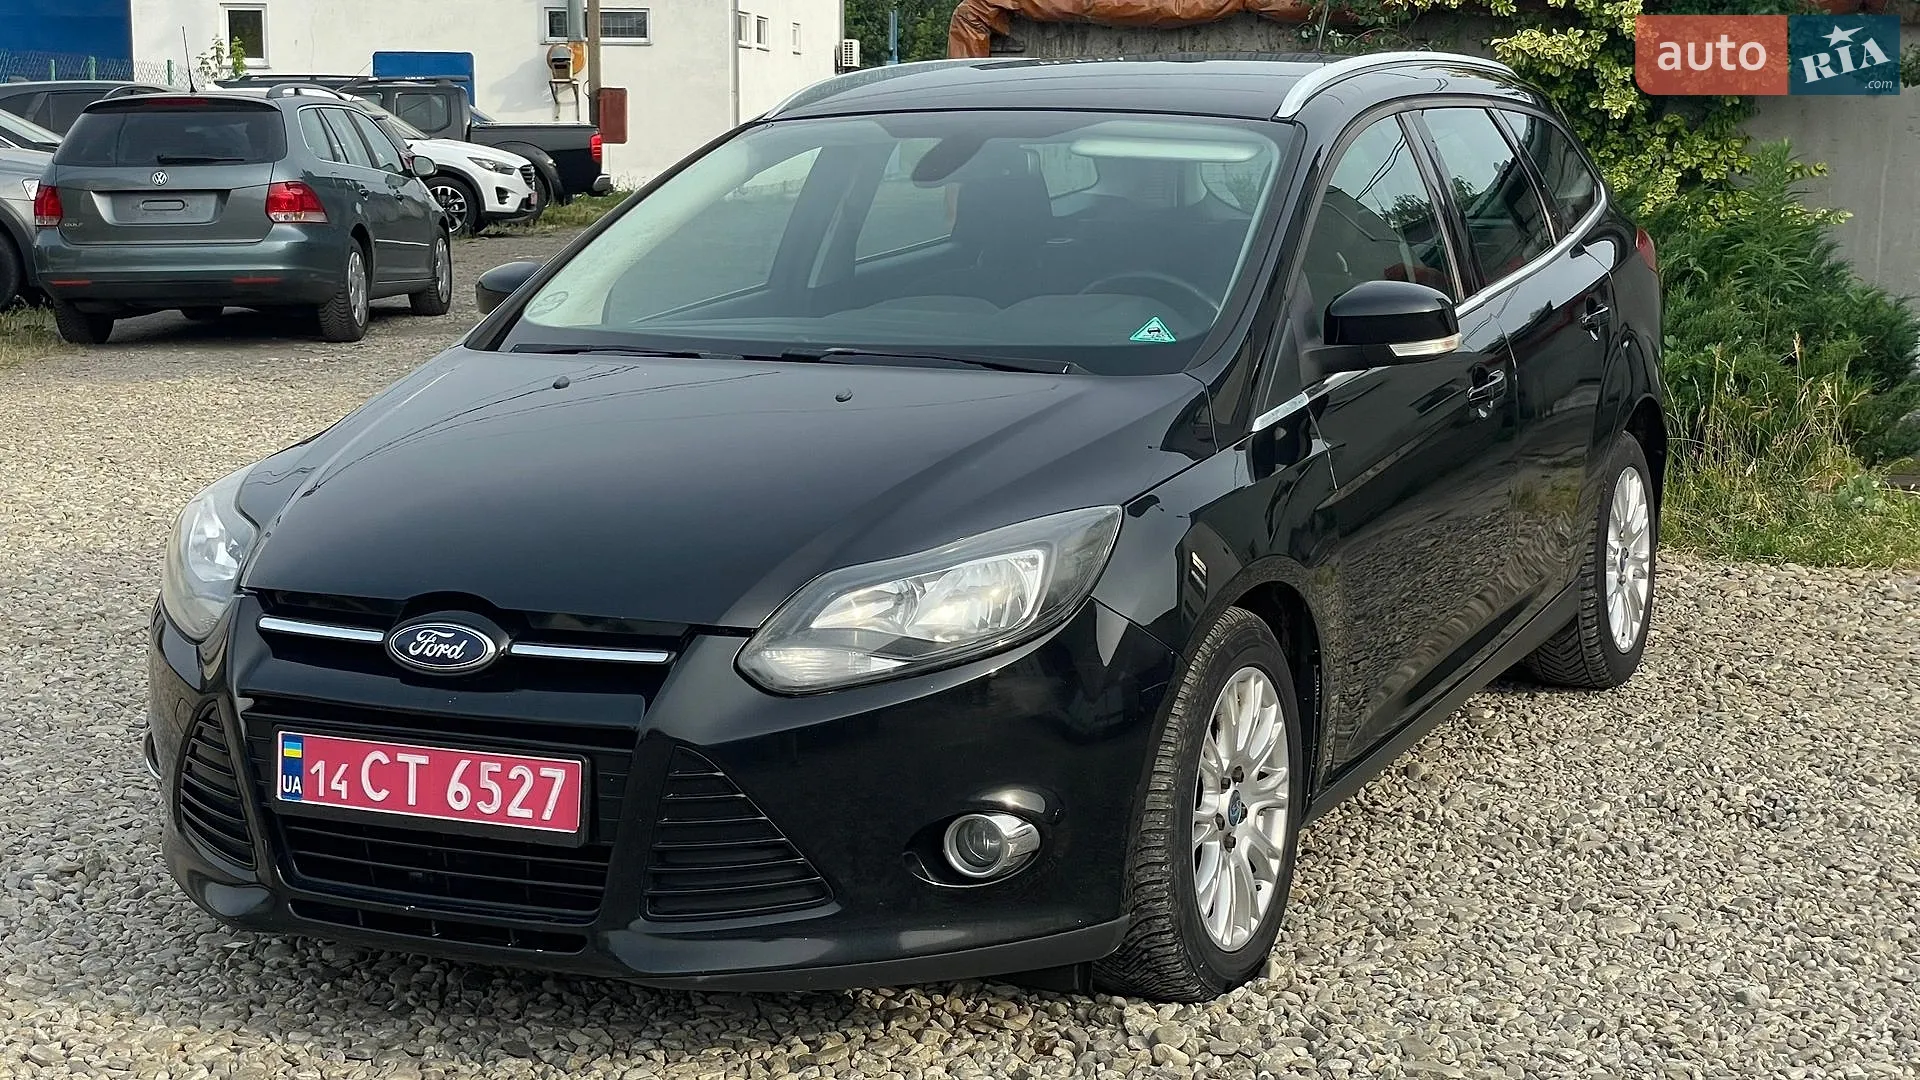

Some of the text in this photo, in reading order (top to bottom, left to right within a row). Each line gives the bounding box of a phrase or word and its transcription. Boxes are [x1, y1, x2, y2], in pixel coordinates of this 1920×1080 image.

[408, 629, 468, 660] Ford
[282, 774, 303, 795] UA
[309, 750, 566, 821] 14 CT 6527
